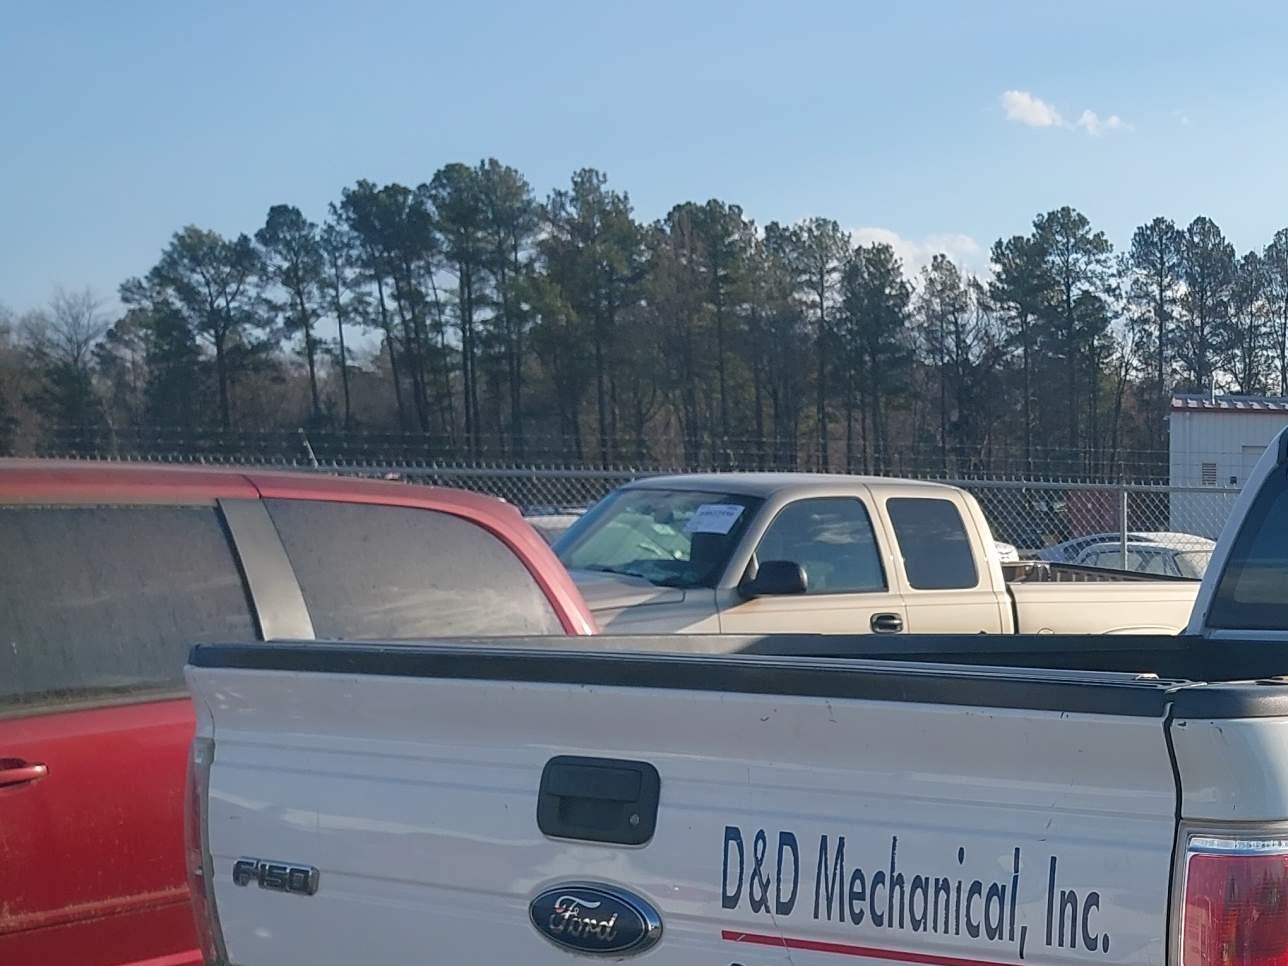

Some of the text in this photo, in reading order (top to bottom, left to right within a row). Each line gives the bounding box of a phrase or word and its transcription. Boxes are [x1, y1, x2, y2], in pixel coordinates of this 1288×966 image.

[549, 895, 619, 940] Ford
[722, 826, 1110, 960] D&D Mechanical, Inc.
